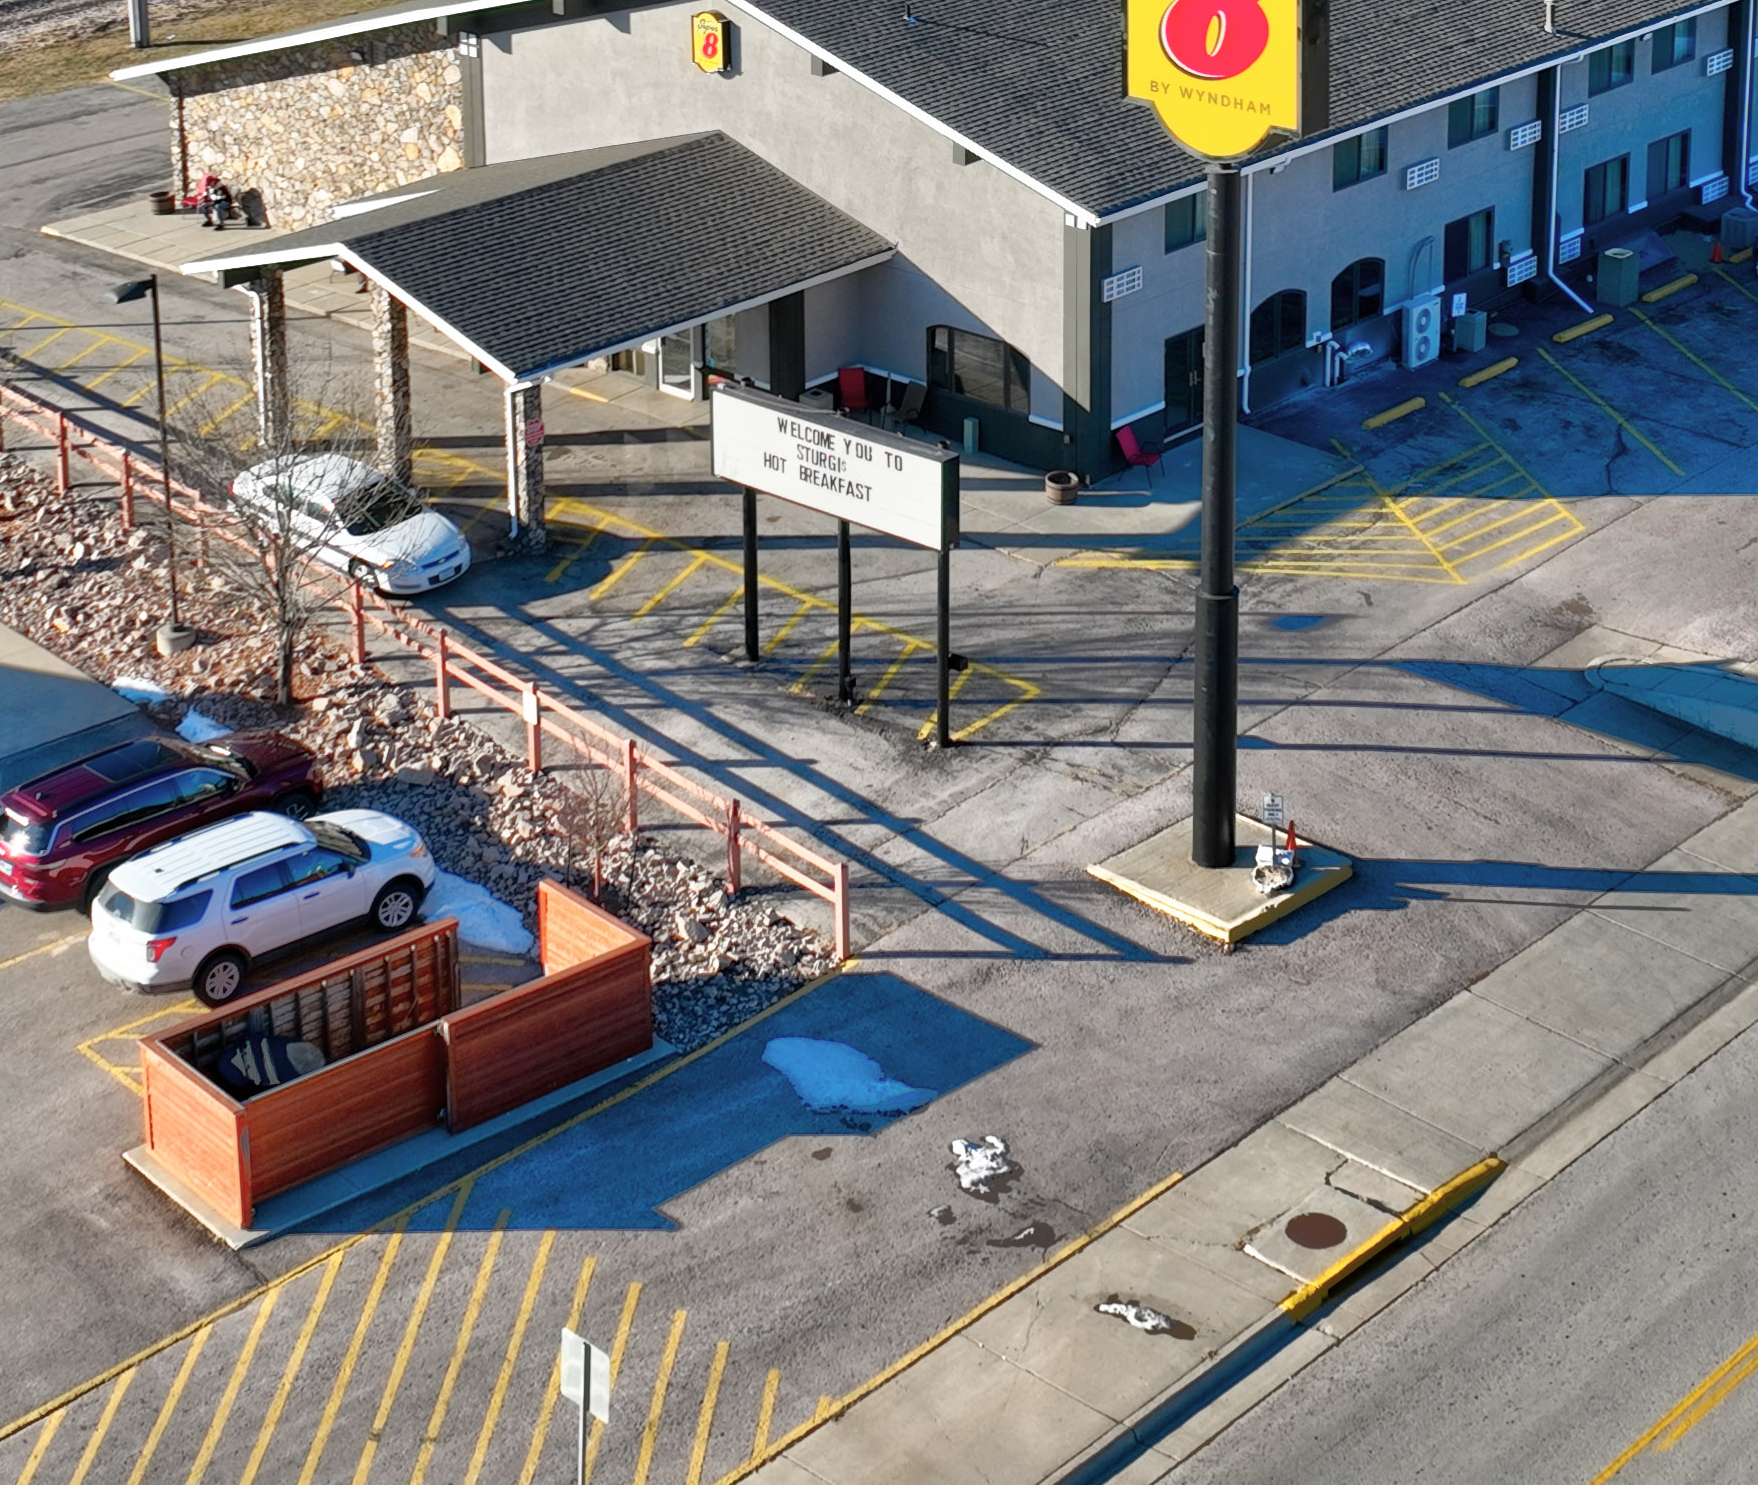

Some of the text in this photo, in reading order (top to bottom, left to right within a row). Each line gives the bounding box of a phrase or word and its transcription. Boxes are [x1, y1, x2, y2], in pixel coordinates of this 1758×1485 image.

[698, 19, 718, 34] Super
[702, 32, 719, 59] 8
[1150, 80, 1272, 116] BY WYNDHAM
[777, 417, 903, 471] WELCOME YOU TO
[797, 444, 846, 472] STURGIS
[763, 452, 872, 502] HOT BREAKFAST
